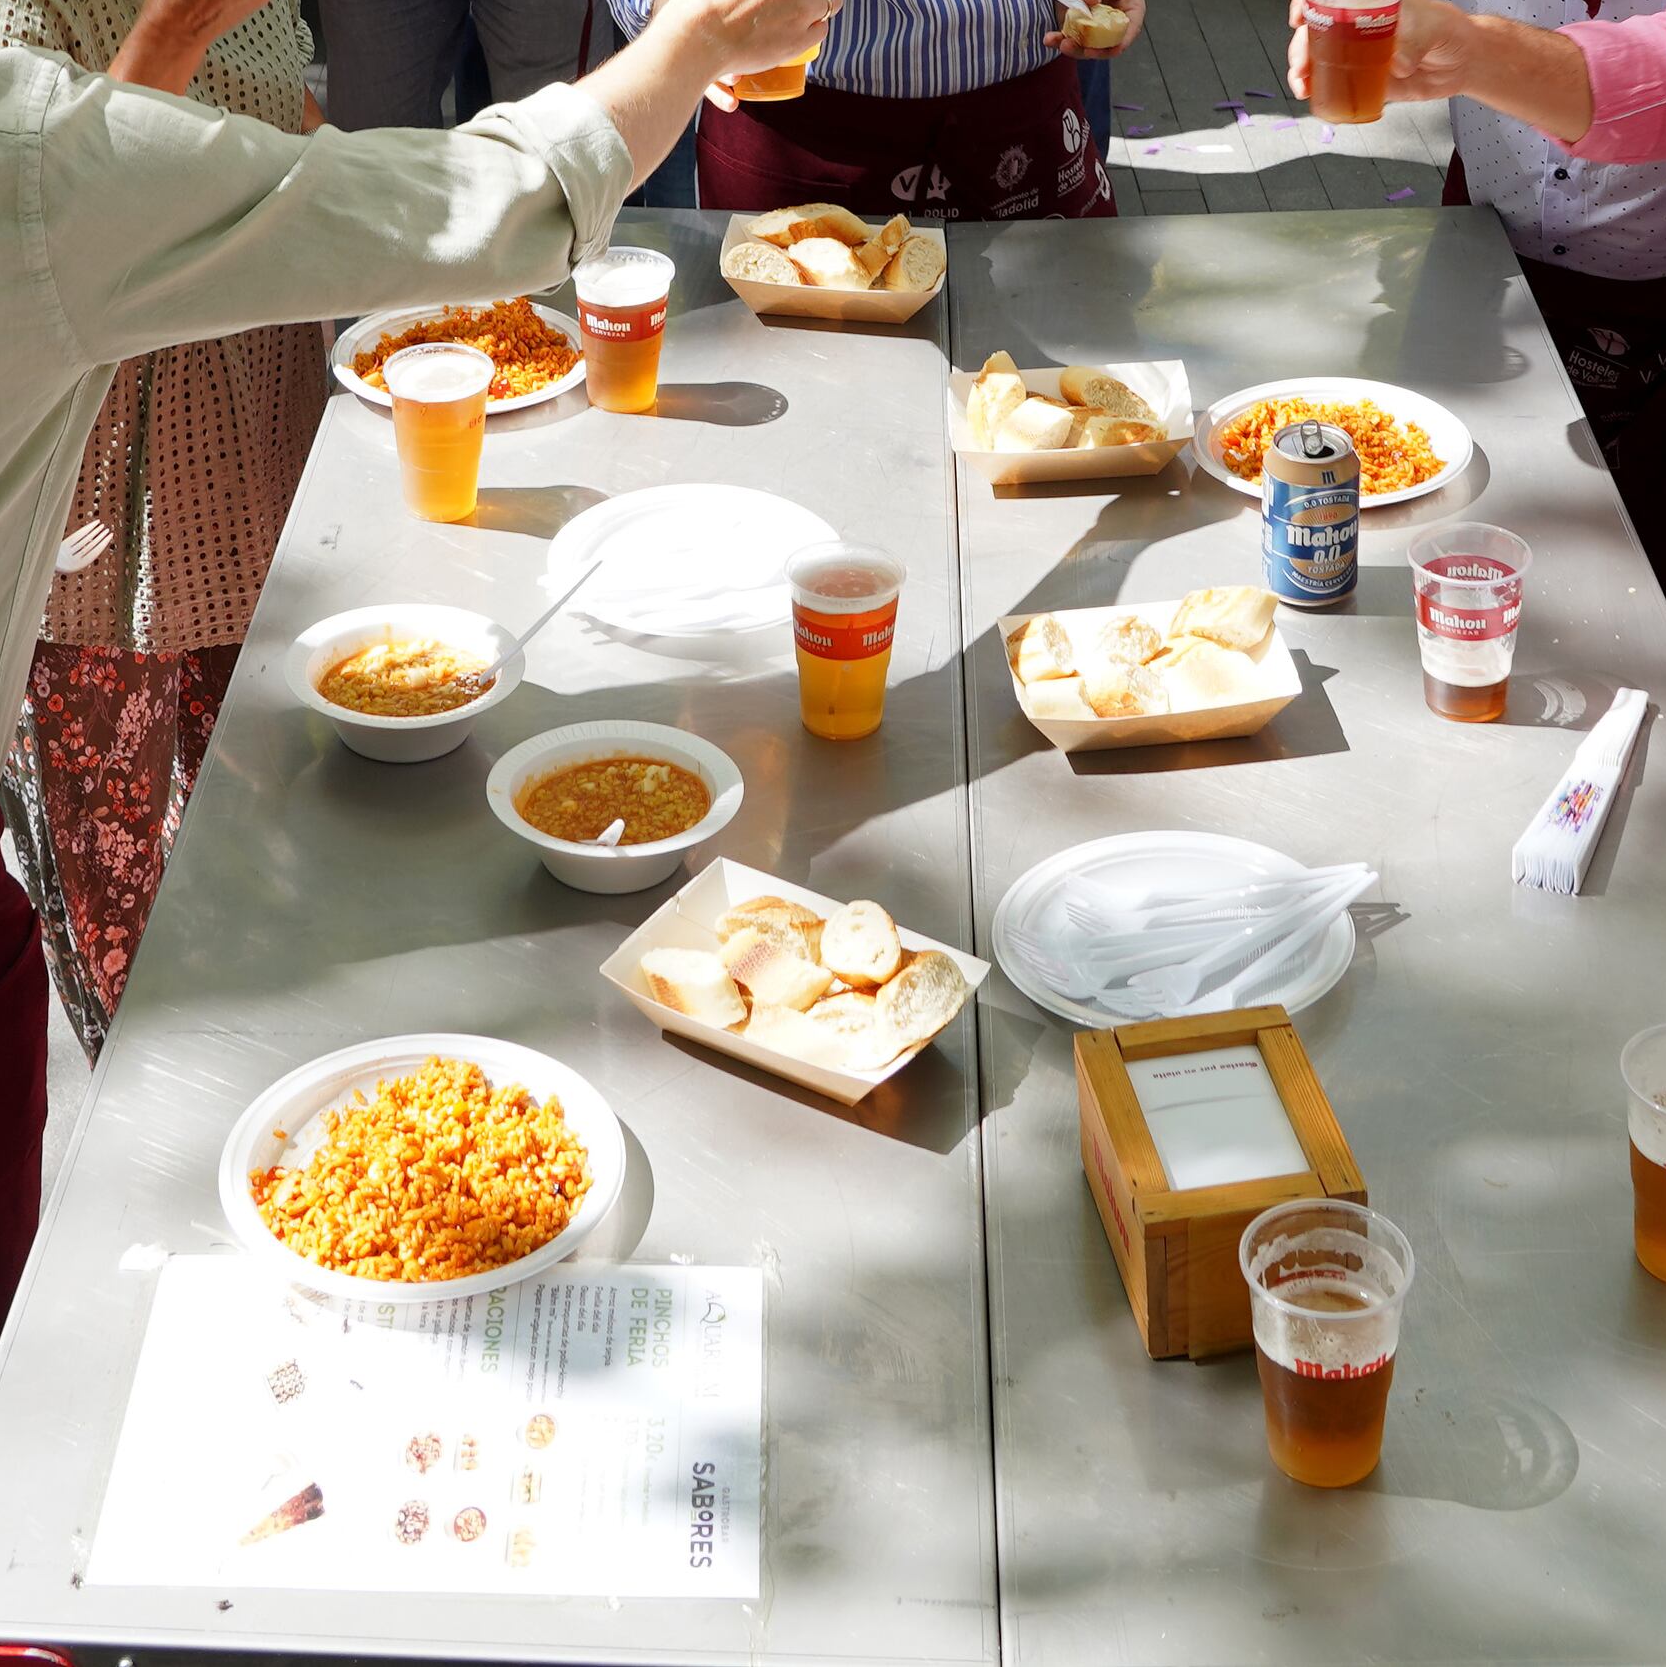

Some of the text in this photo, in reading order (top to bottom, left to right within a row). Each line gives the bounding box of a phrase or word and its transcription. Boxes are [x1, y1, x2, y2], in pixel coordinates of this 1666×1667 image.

[585, 312, 631, 332] Mahou
[1318, 494, 1351, 506] TOSTADA
[1286, 519, 1358, 548] Mahou
[1307, 562, 1346, 575] TOSTADA
[1429, 606, 1486, 630] Mahou
[1092, 1131, 1131, 1259] Mahou
[627, 1286, 650, 1368] DE FERIA
[651, 1287, 673, 1370] PINCHOS
[1294, 1352, 1391, 1382] Mahou
